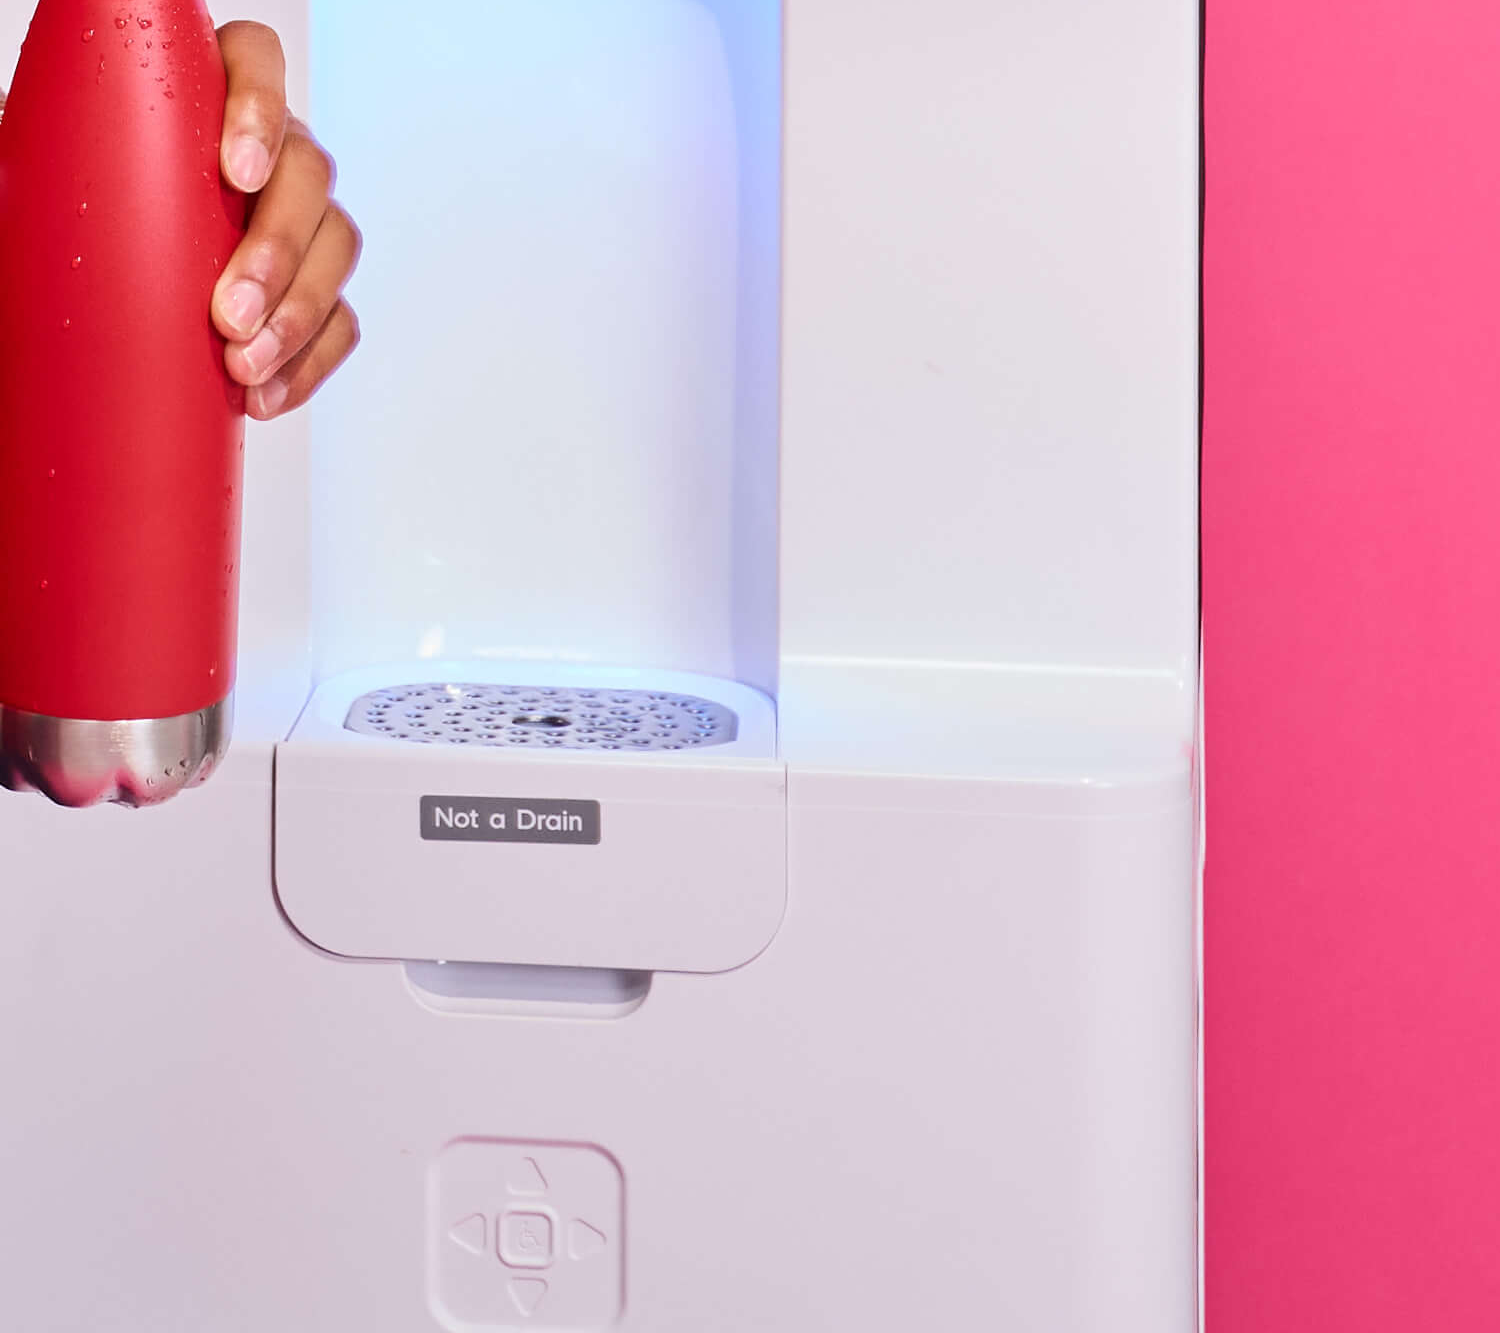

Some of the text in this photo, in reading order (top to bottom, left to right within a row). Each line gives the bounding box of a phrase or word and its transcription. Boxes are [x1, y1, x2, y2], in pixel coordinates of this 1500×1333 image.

[435, 807, 582, 831] Not a Drain
